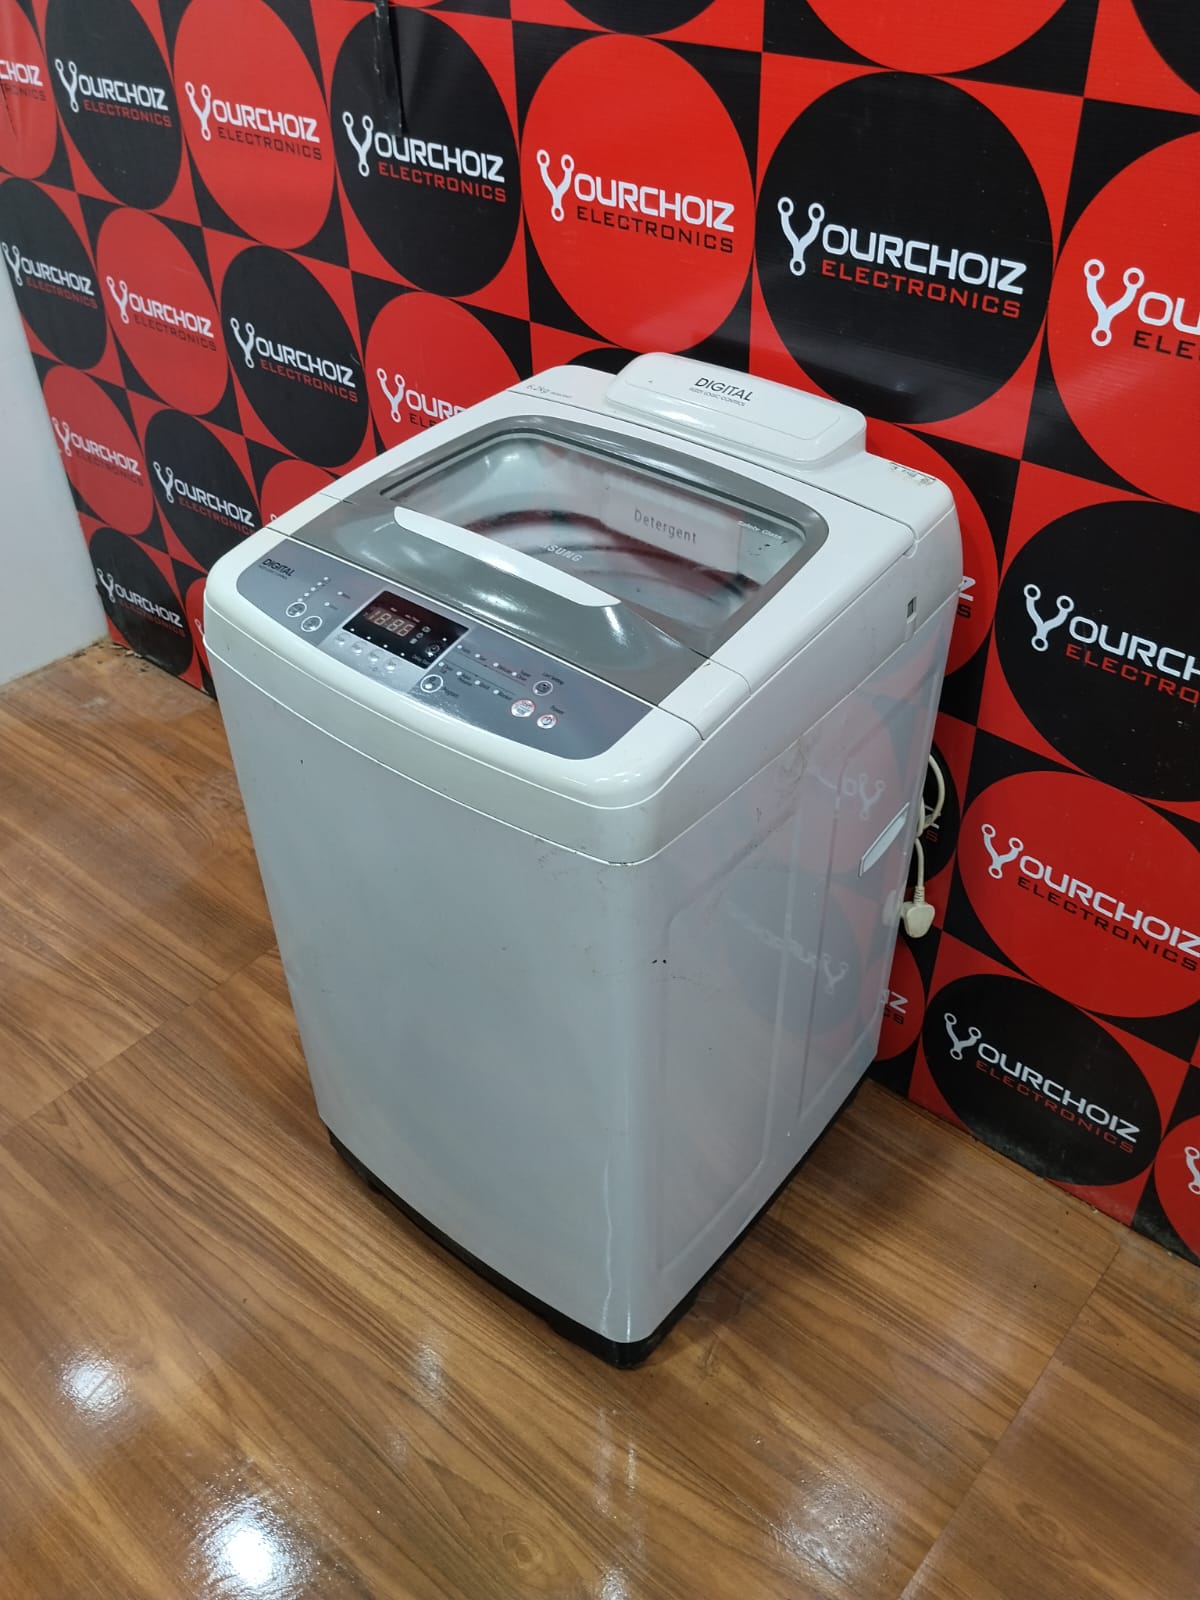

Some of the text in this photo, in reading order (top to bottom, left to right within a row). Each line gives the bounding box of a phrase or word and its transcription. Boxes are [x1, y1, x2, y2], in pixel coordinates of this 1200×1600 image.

[54, 58, 169, 113] YOURCHOIZ
[83, 99, 173, 128] ELECTRONICS
[184, 81, 320, 142] YOURCHOIZ
[218, 127, 322, 161] ELECTRONICS
[342, 111, 505, 183] YOURCHOIZ
[378, 160, 507, 203] ELECTRONICS
[536, 149, 735, 232] YOURCHOIZ
[576, 206, 734, 254] ELECTRONICS
[777, 196, 1028, 295] YOURCHOIZ
[1, 241, 95, 296] YOURCHOIZ
[821, 259, 1021, 319] ELECTRONICS
[106, 275, 214, 338] YOURCHOIZ
[134, 314, 217, 352] ELECTRONICS
[230, 317, 356, 387] YOURCHOIZ
[260, 360, 358, 403] ELECTRONICS
[694, 377, 753, 402] DIGITAL
[51, 416, 142, 476] YOURCHOIZ
[153, 461, 256, 528] YOURCHOIZ
[633, 508, 698, 545] Detergent
[96, 567, 184, 628] YOURCHOIZ
[262, 558, 295, 577] DIGITAL
[981, 823, 1200, 958] YOURCHOIZ
[1017, 876, 1197, 972] ELECTRONICS
[944, 1012, 1141, 1144] YOURCHOIZ
[975, 1060, 1135, 1155] ELECTRONICS
